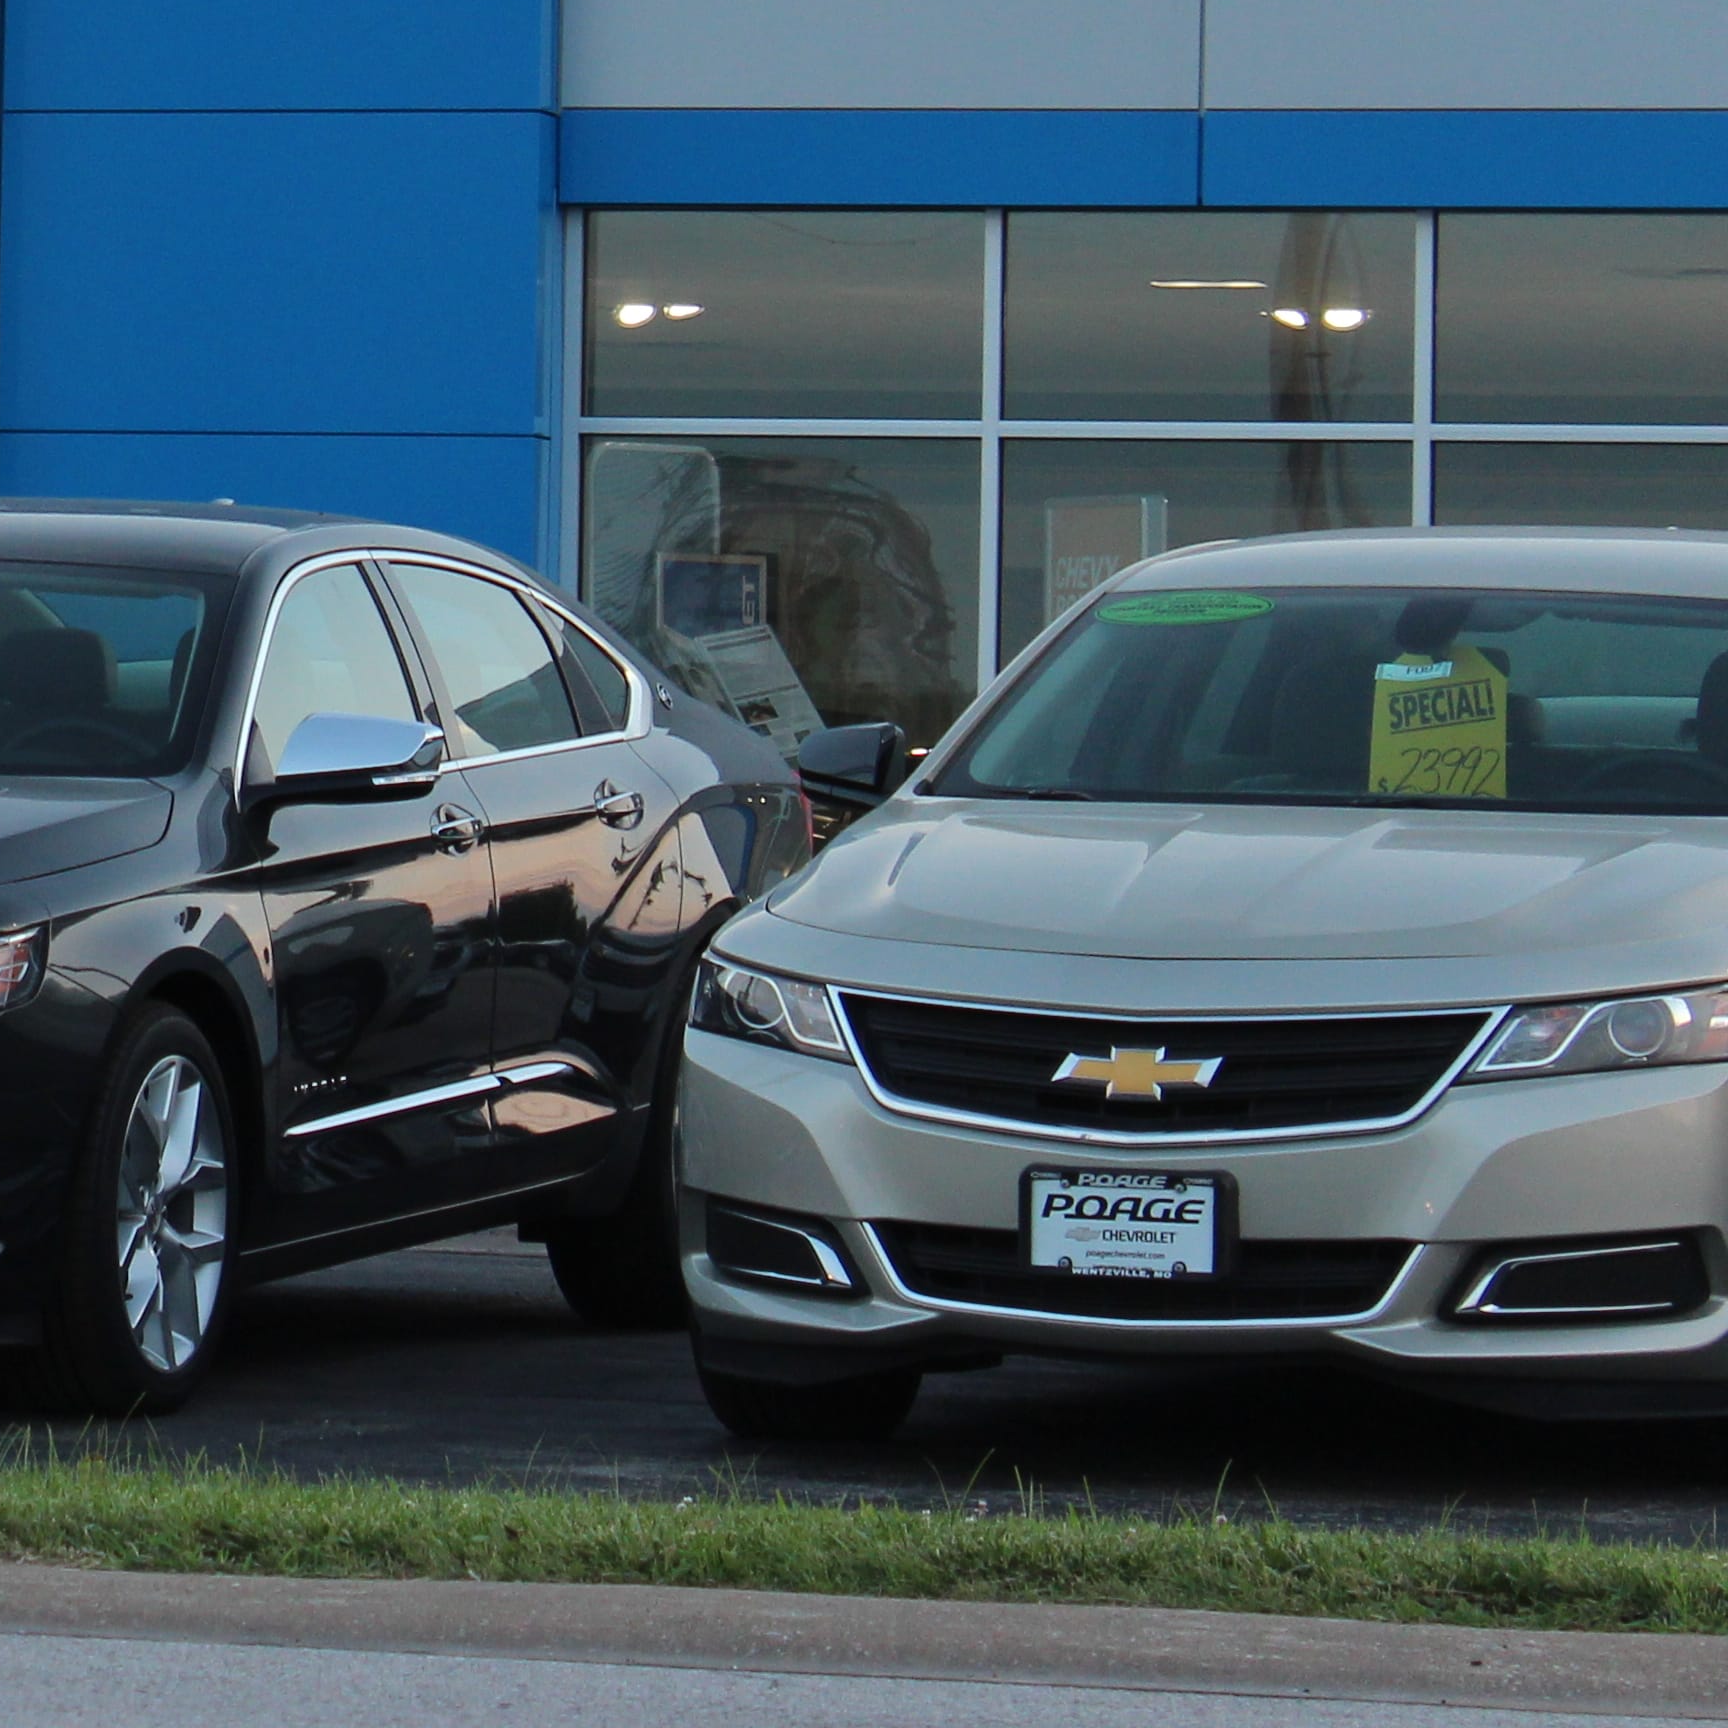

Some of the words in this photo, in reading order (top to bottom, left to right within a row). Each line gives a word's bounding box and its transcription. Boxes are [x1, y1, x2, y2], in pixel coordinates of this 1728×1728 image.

[1388, 681, 1495, 731] SPECIAL!
[1078, 1173, 1168, 1189] POAGE
[1041, 1194, 1206, 1224] POAGE
[1102, 1229, 1177, 1244] CHEVROLET
